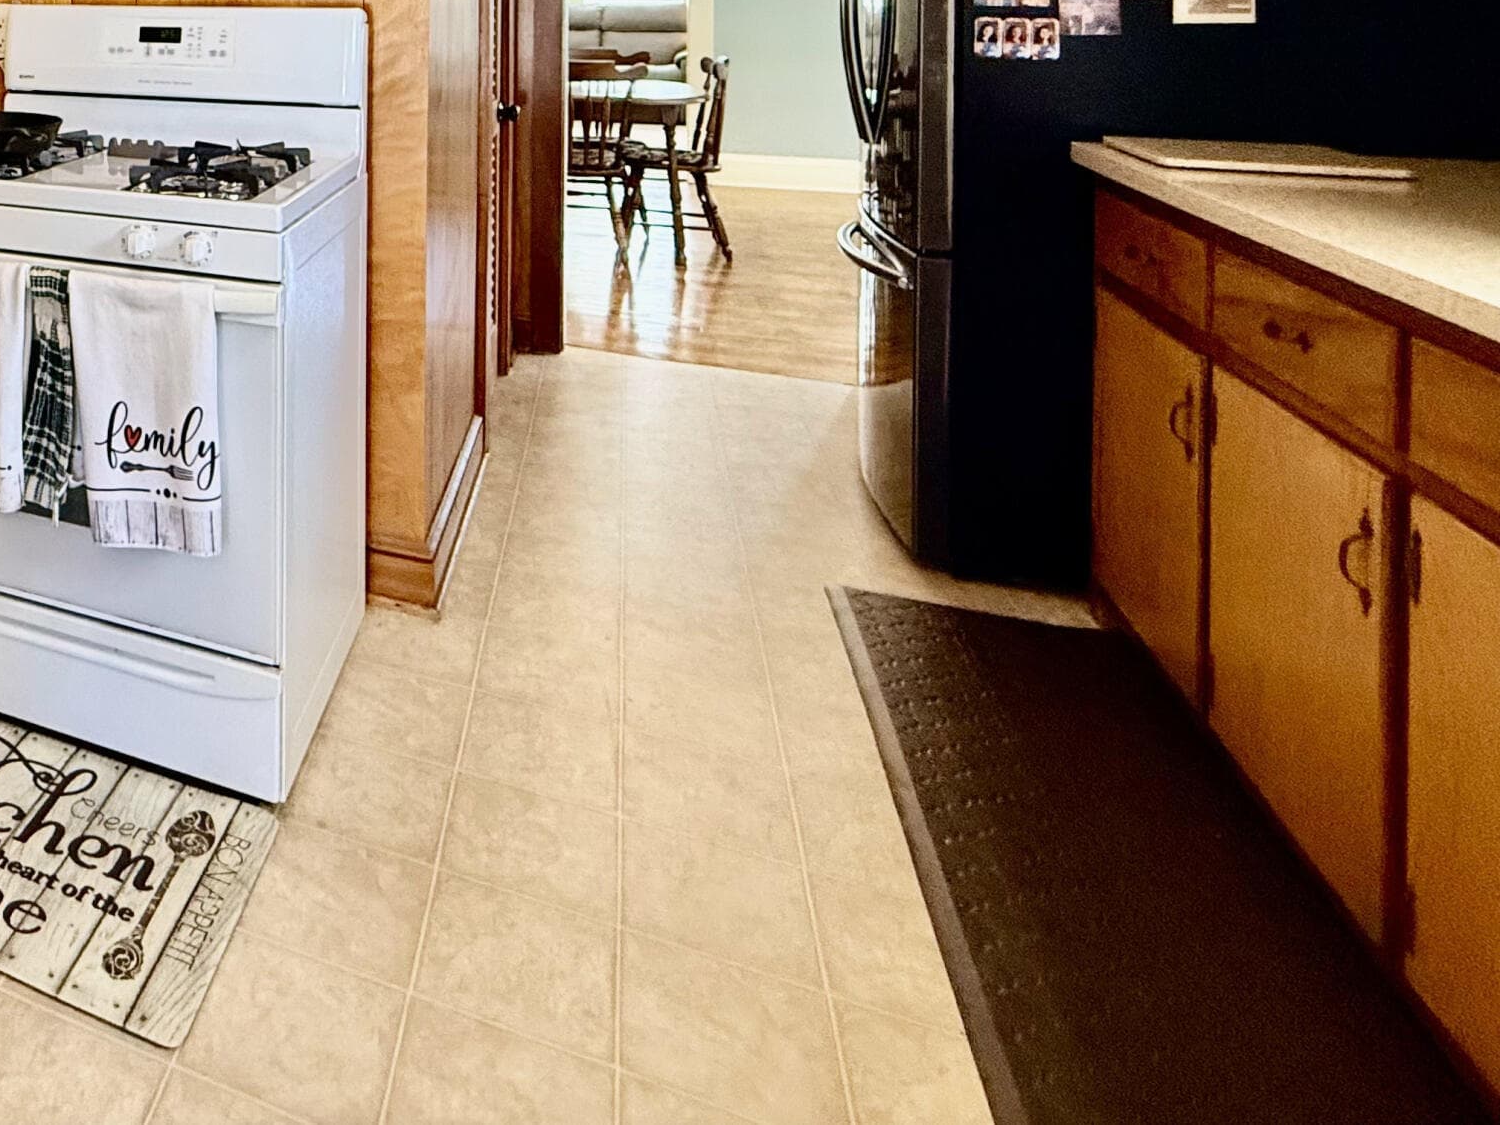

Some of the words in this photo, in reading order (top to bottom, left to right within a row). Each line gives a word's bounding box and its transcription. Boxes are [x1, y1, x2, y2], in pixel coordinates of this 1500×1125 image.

[94, 401, 220, 491] fmily
[70, 797, 160, 847] Cheers
[205, 832, 252, 887] BON
[61, 882, 95, 903] of
[91, 891, 135, 923] the
